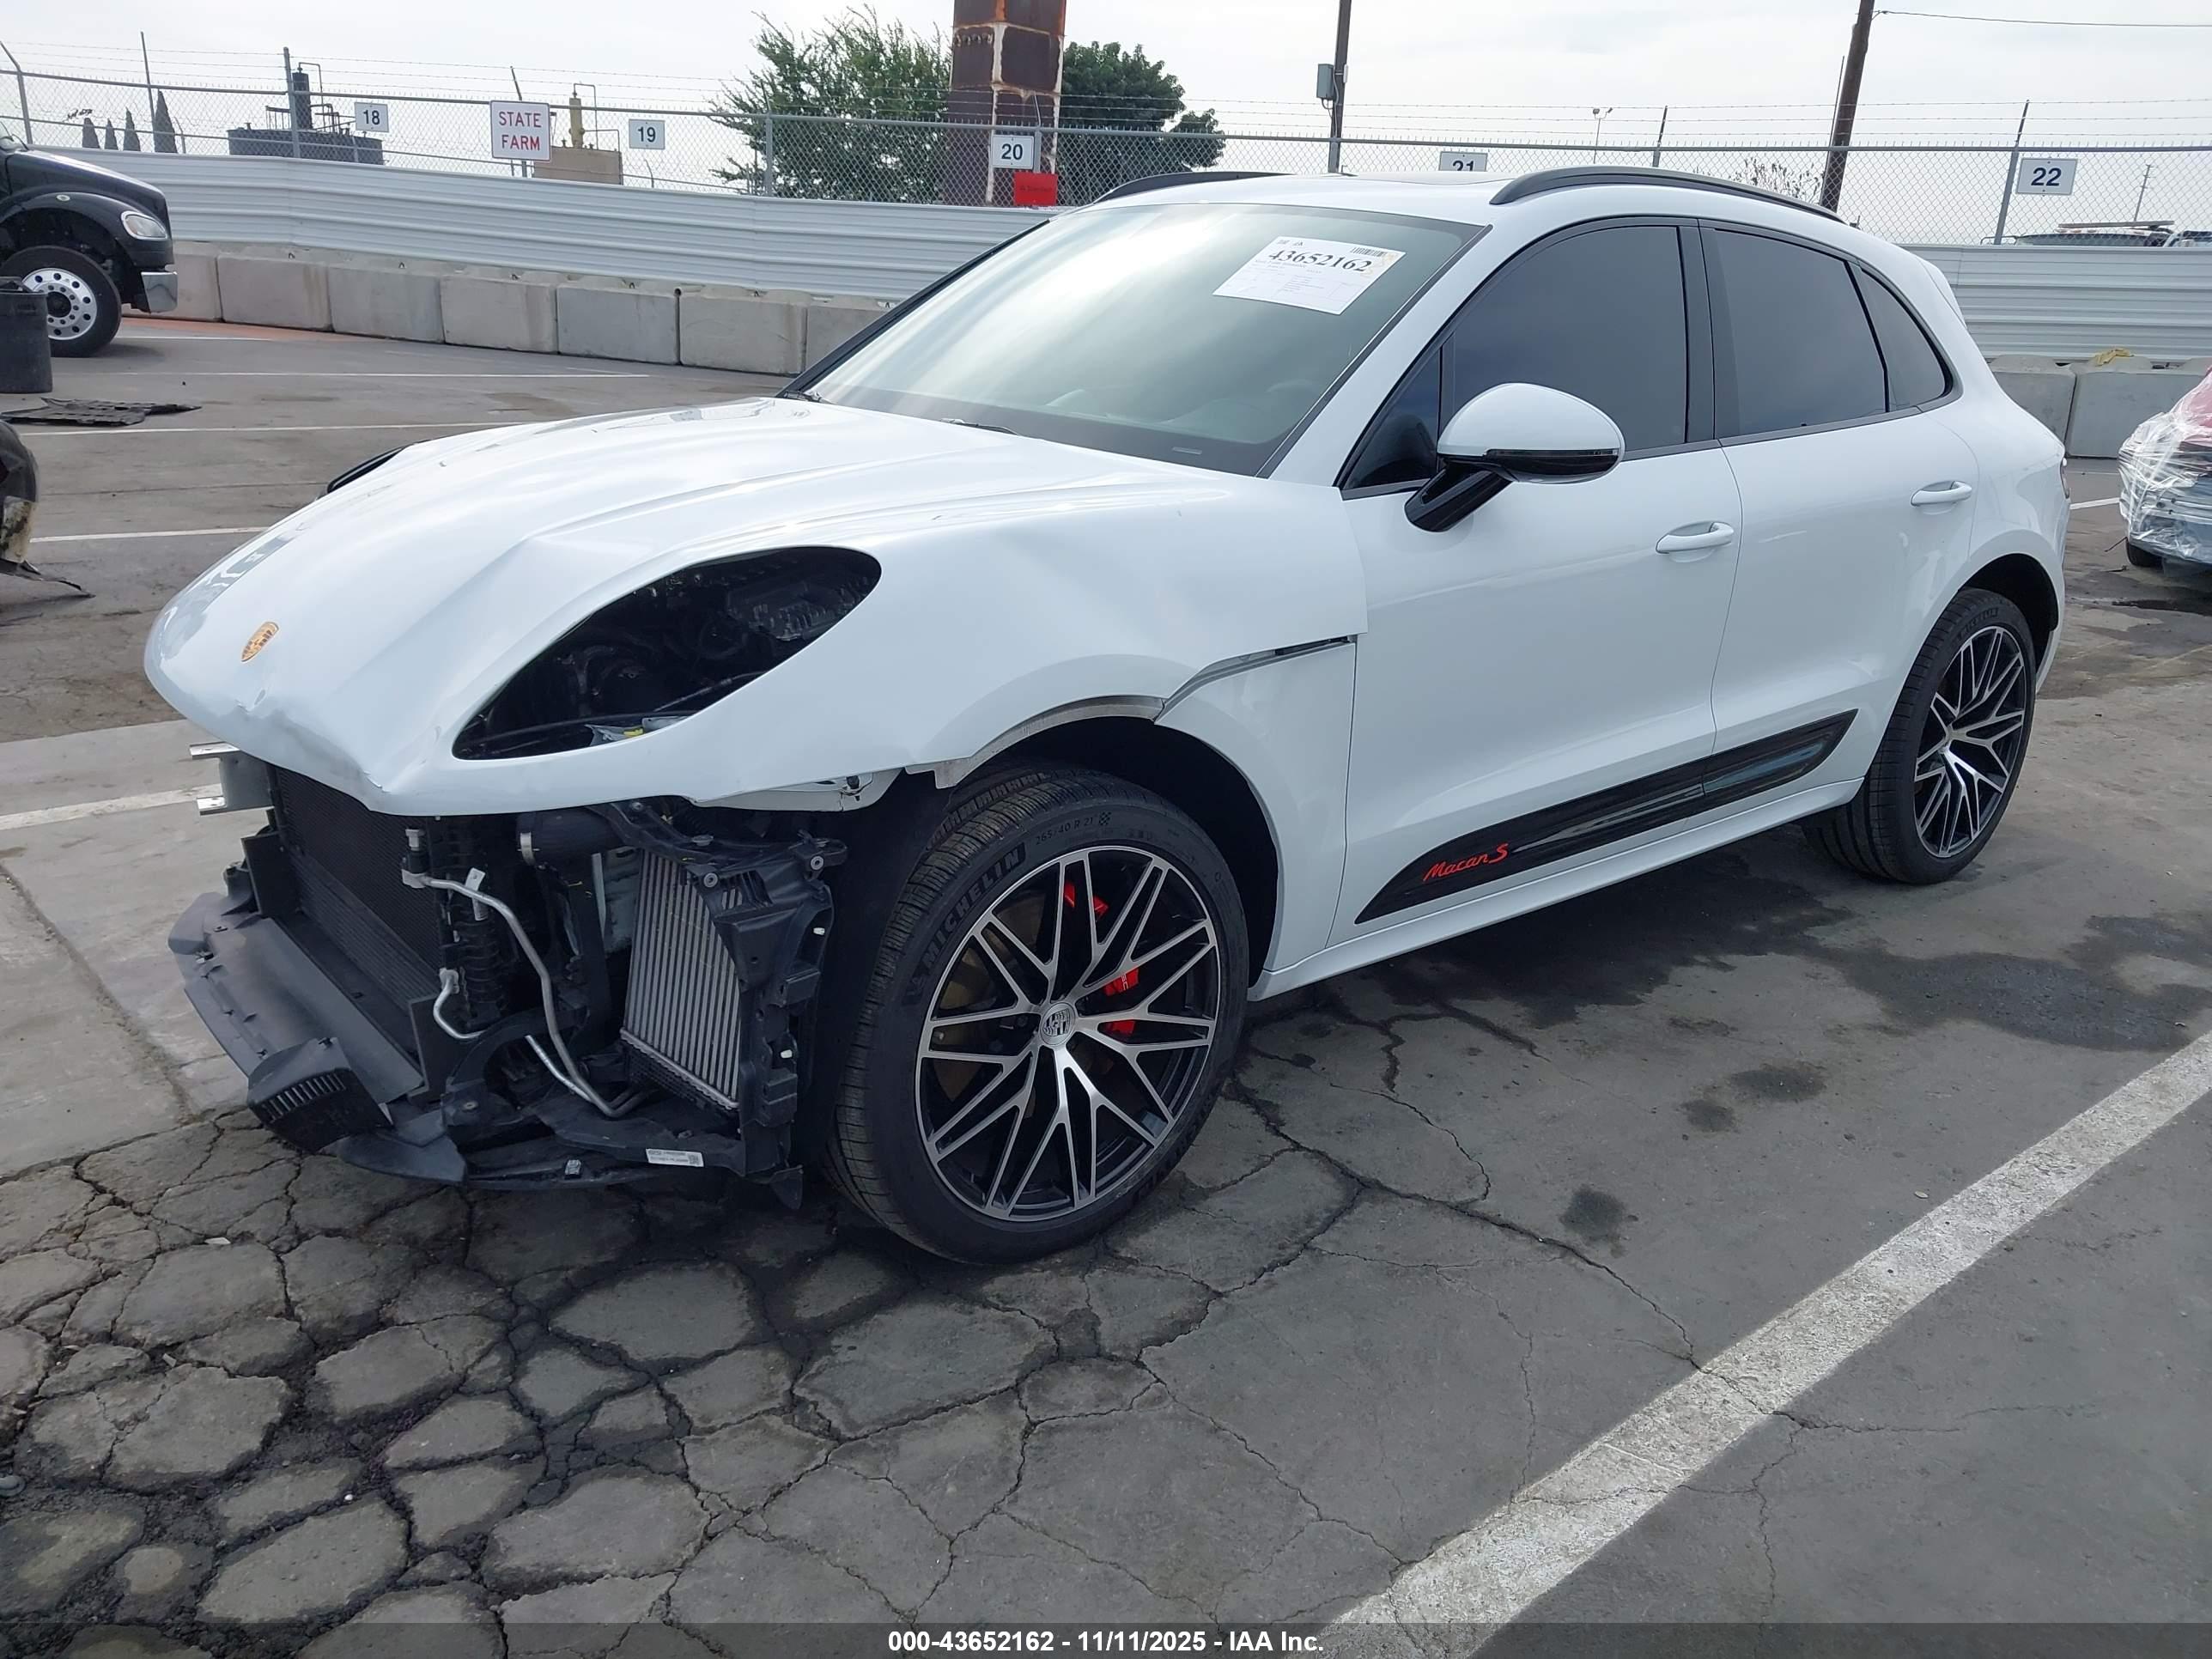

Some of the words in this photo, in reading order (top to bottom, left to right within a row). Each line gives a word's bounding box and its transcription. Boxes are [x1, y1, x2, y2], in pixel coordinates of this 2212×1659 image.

[362, 109, 380, 125] 18
[498, 111, 542, 128] STATE
[501, 134, 540, 151] FARM
[637, 126, 656, 143] 19
[1001, 143, 1023, 161] 20
[1452, 160, 1474, 172] 21
[2031, 167, 2062, 186] 22
[1268, 248, 1373, 272] 43652162
[1423, 854, 1489, 882] Macan
[1488, 842, 1509, 864] S
[921, 845, 1021, 969] MICHELIN
